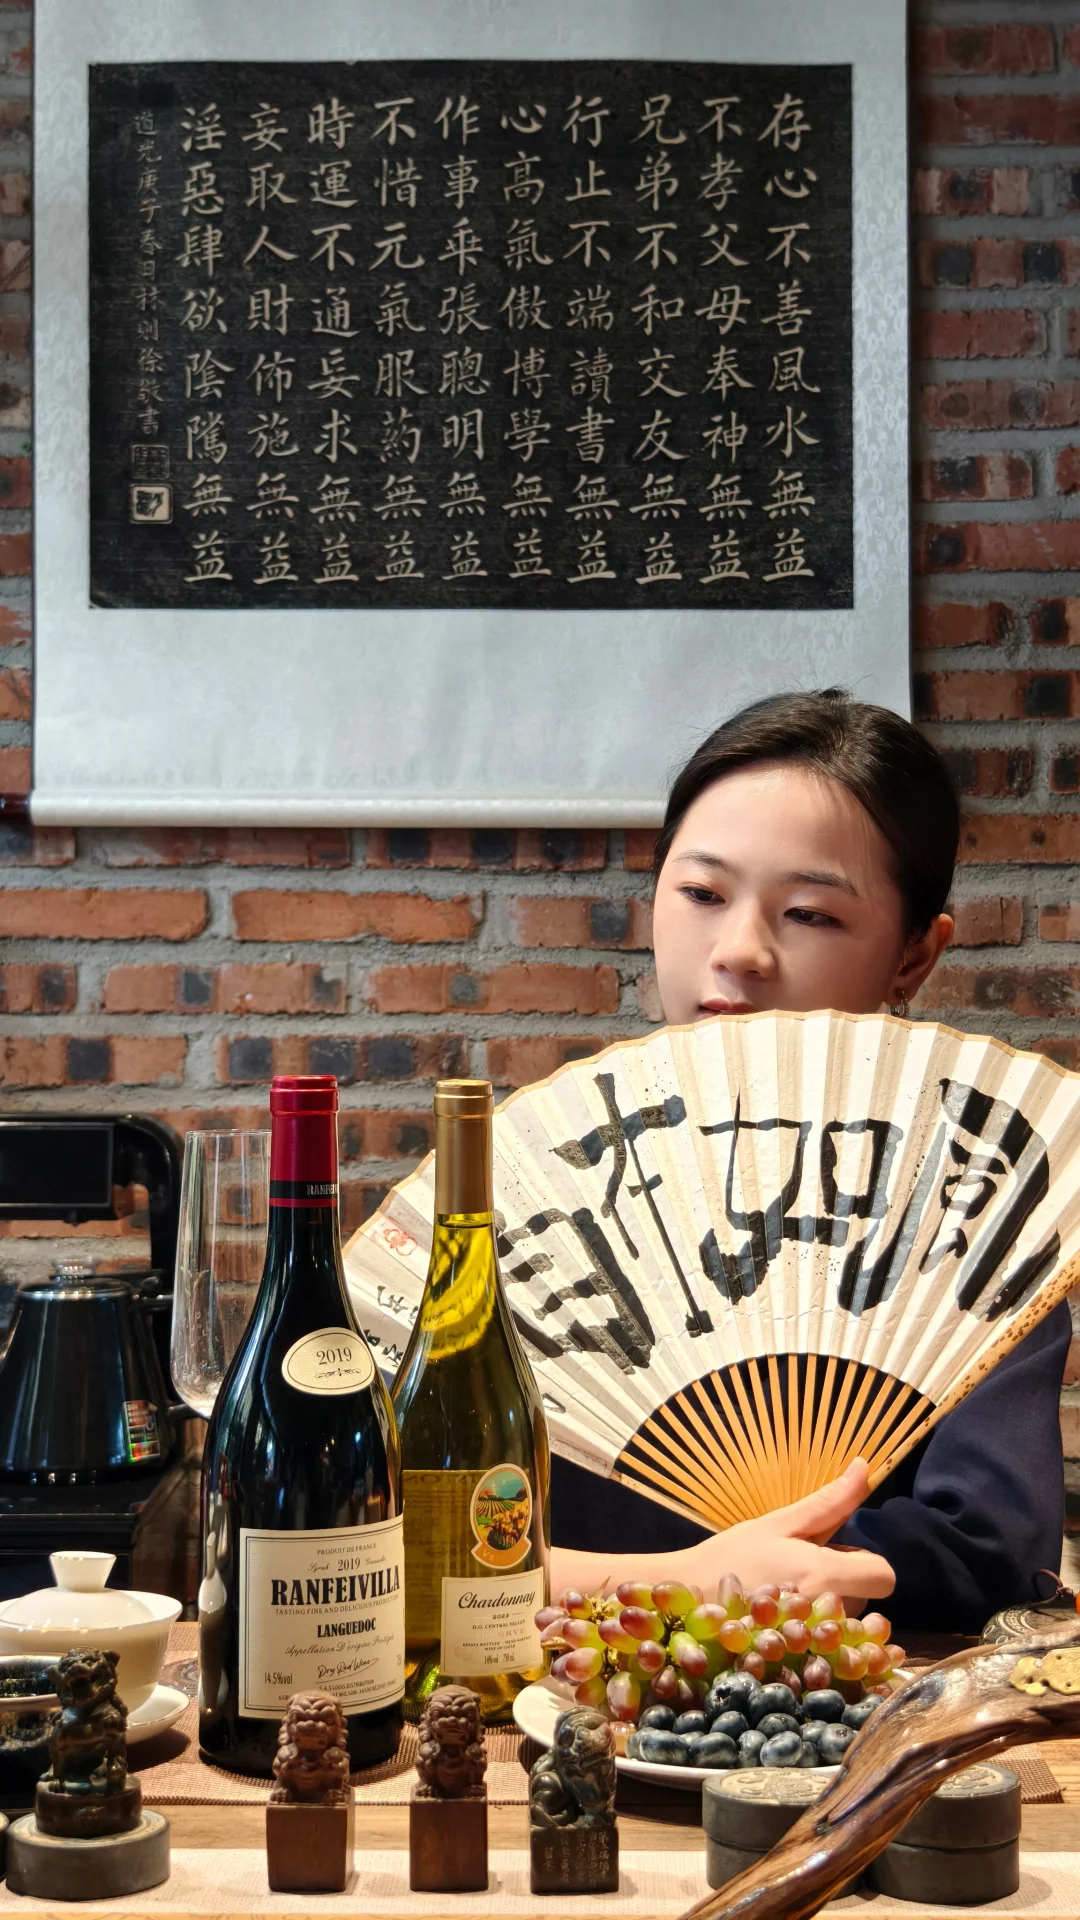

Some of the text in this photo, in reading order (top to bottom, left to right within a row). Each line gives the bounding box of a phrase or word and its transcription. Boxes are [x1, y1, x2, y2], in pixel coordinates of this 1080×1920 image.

[499, 98, 554, 579] 心高氣傲博學無益
[562, 95, 620, 584] 行止不端讀書無益
[629, 97, 692, 584] 兄弟不和交友無益
[694, 95, 756, 584] 不孝父母奉神無益
[758, 93, 820, 583] 存心不善風水無益
[315, 1345, 354, 1366] 2019
[316, 1547, 346, 1557] PRODUIT
[355, 1542, 377, 1552] FRANCE
[337, 1556, 361, 1572] 2019
[270, 1564, 401, 1606] RANFEIVILLA
[275, 1608, 306, 1616] TASTING
[306, 1607, 323, 1615] FINE
[323, 1606, 339, 1614] AND
[339, 1601, 373, 1612] DELICIOUS
[458, 1591, 536, 1609] Chardonnay
[316, 1617, 377, 1638] LANGUEDOC
[484, 1621, 509, 1629] CENTRAL
[284, 1643, 335, 1658] Appellation
[264, 1671, 293, 1685] 14.5%vol
[317, 1664, 336, 1679] Dry
[336, 1660, 353, 1676] Red
